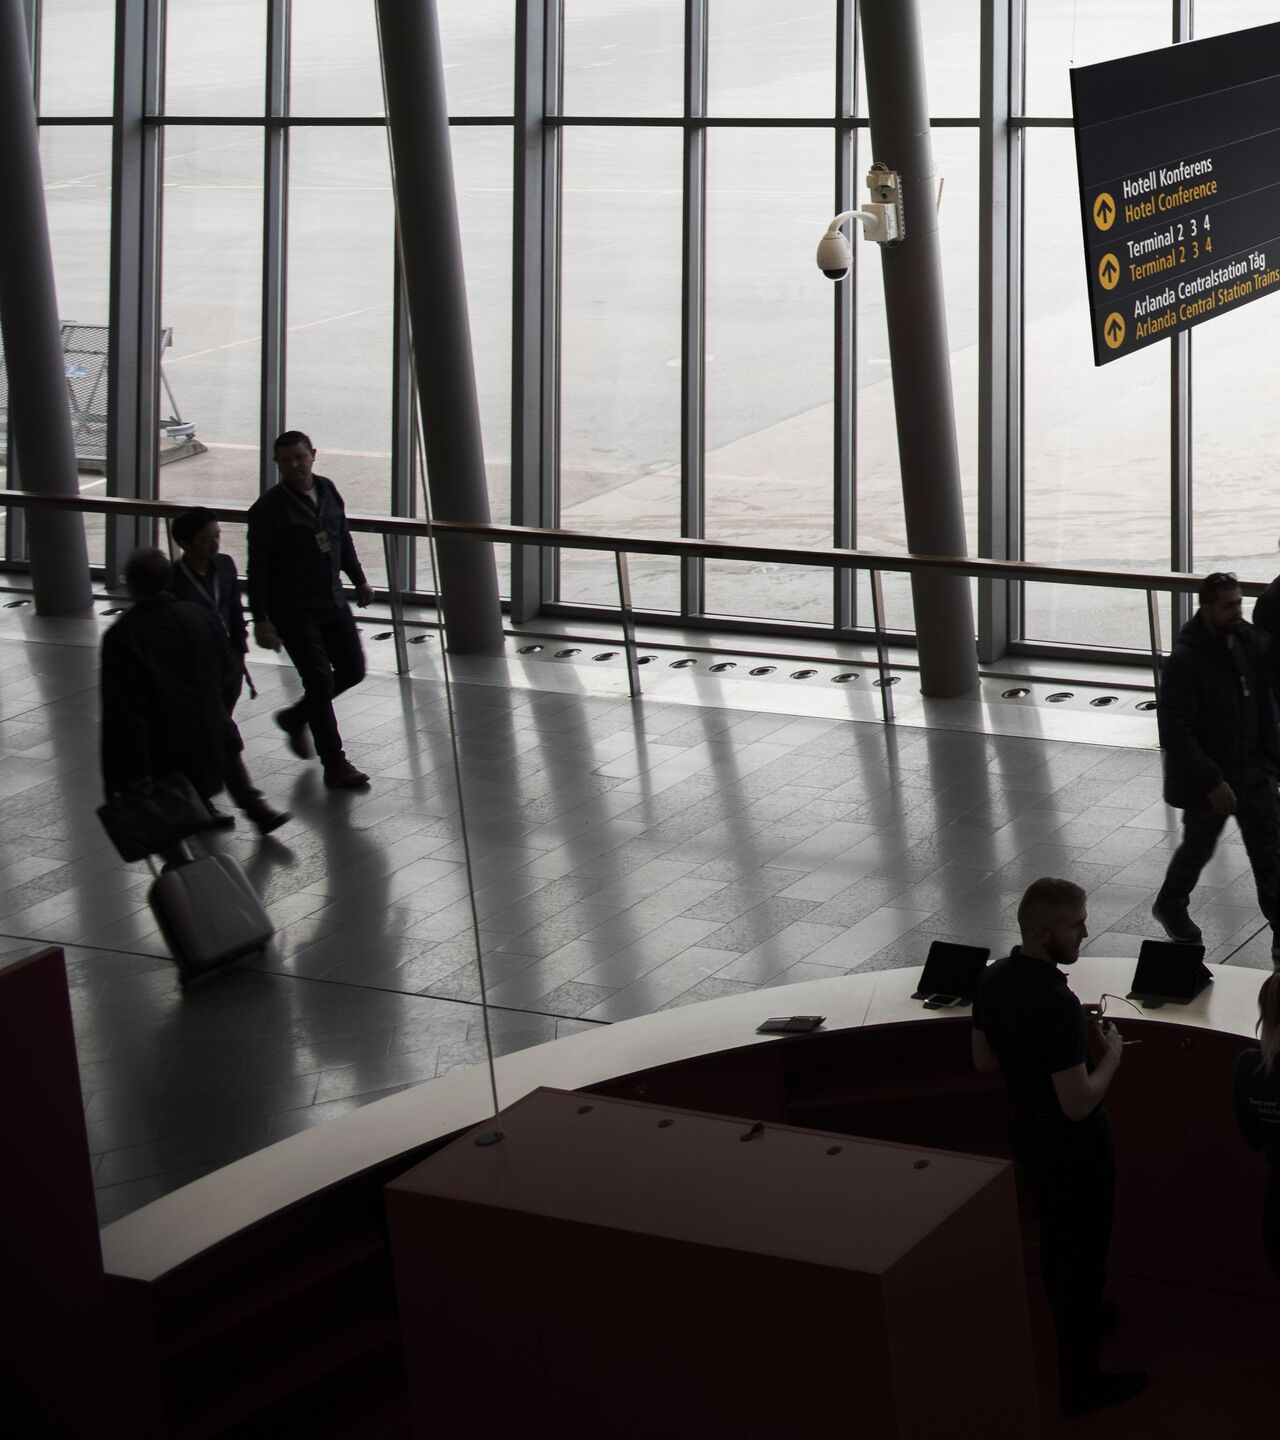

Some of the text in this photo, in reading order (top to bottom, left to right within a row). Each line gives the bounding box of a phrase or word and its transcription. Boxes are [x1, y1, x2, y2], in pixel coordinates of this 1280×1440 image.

[1123, 158, 1213, 199] Hotell Konferens
[1125, 180, 1218, 223] Hotel Conference
[1127, 214, 1211, 258] Terminal 2 3 4
[1129, 236, 1213, 282] Terminal 2 3 4
[1134, 251, 1266, 318] Arlanda Centralstation Tåg
[1136, 267, 1280, 340] Arlanda Central Station Trains
